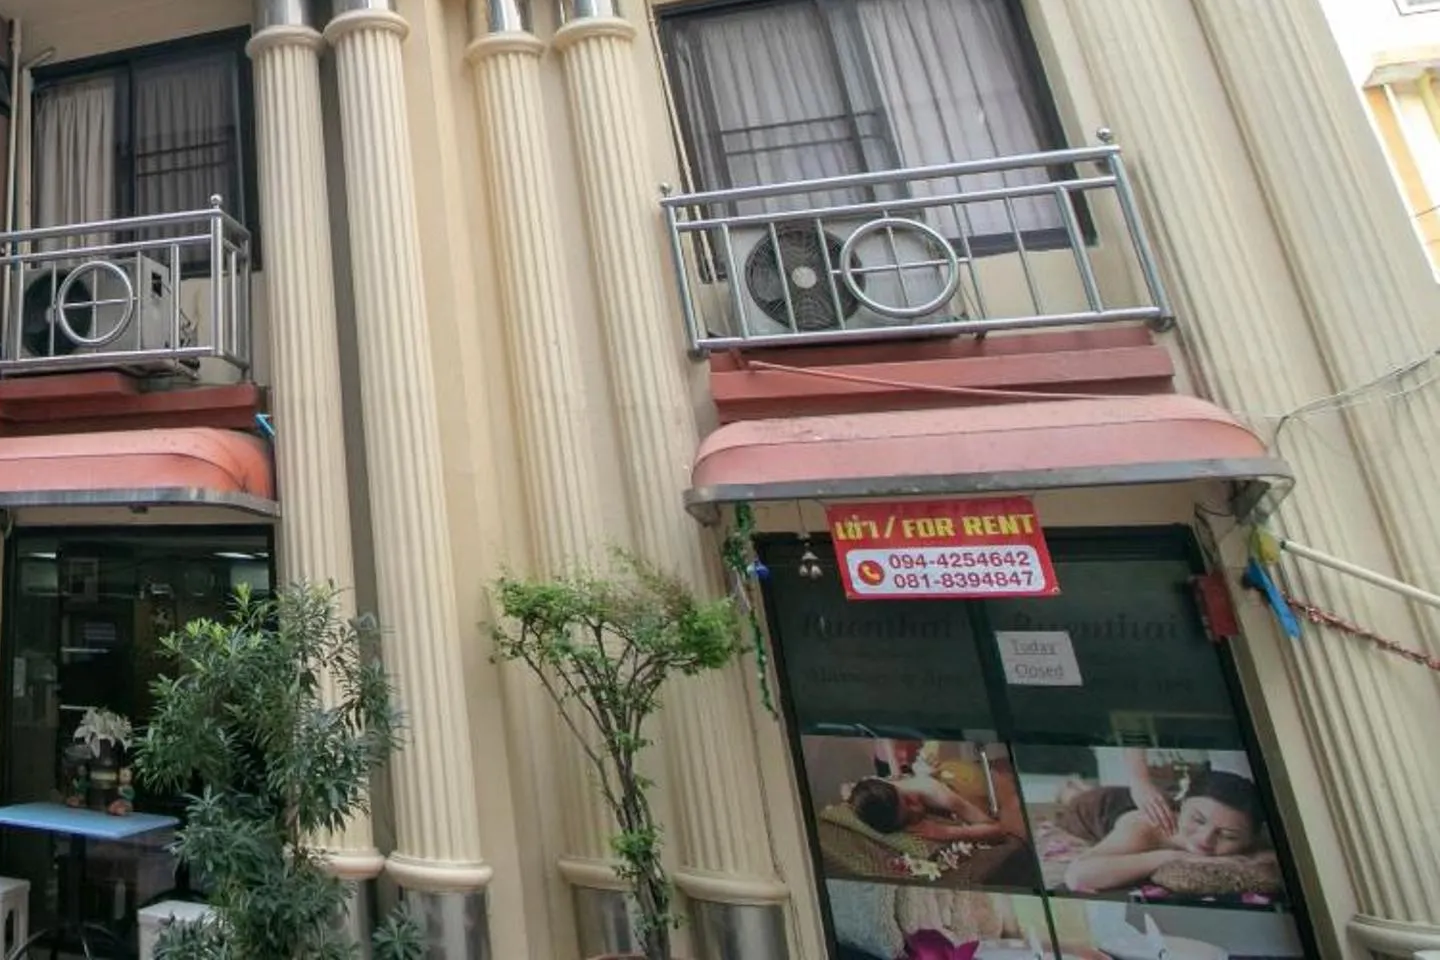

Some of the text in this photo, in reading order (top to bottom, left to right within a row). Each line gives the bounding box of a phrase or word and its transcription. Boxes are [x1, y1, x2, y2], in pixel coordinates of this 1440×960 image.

[902, 516, 956, 538] FOR
[962, 513, 1035, 536] RENT
[888, 551, 1031, 569] 094-4254642
[893, 571, 1034, 589] 081-8394847
[1014, 663, 1064, 679] Closed
